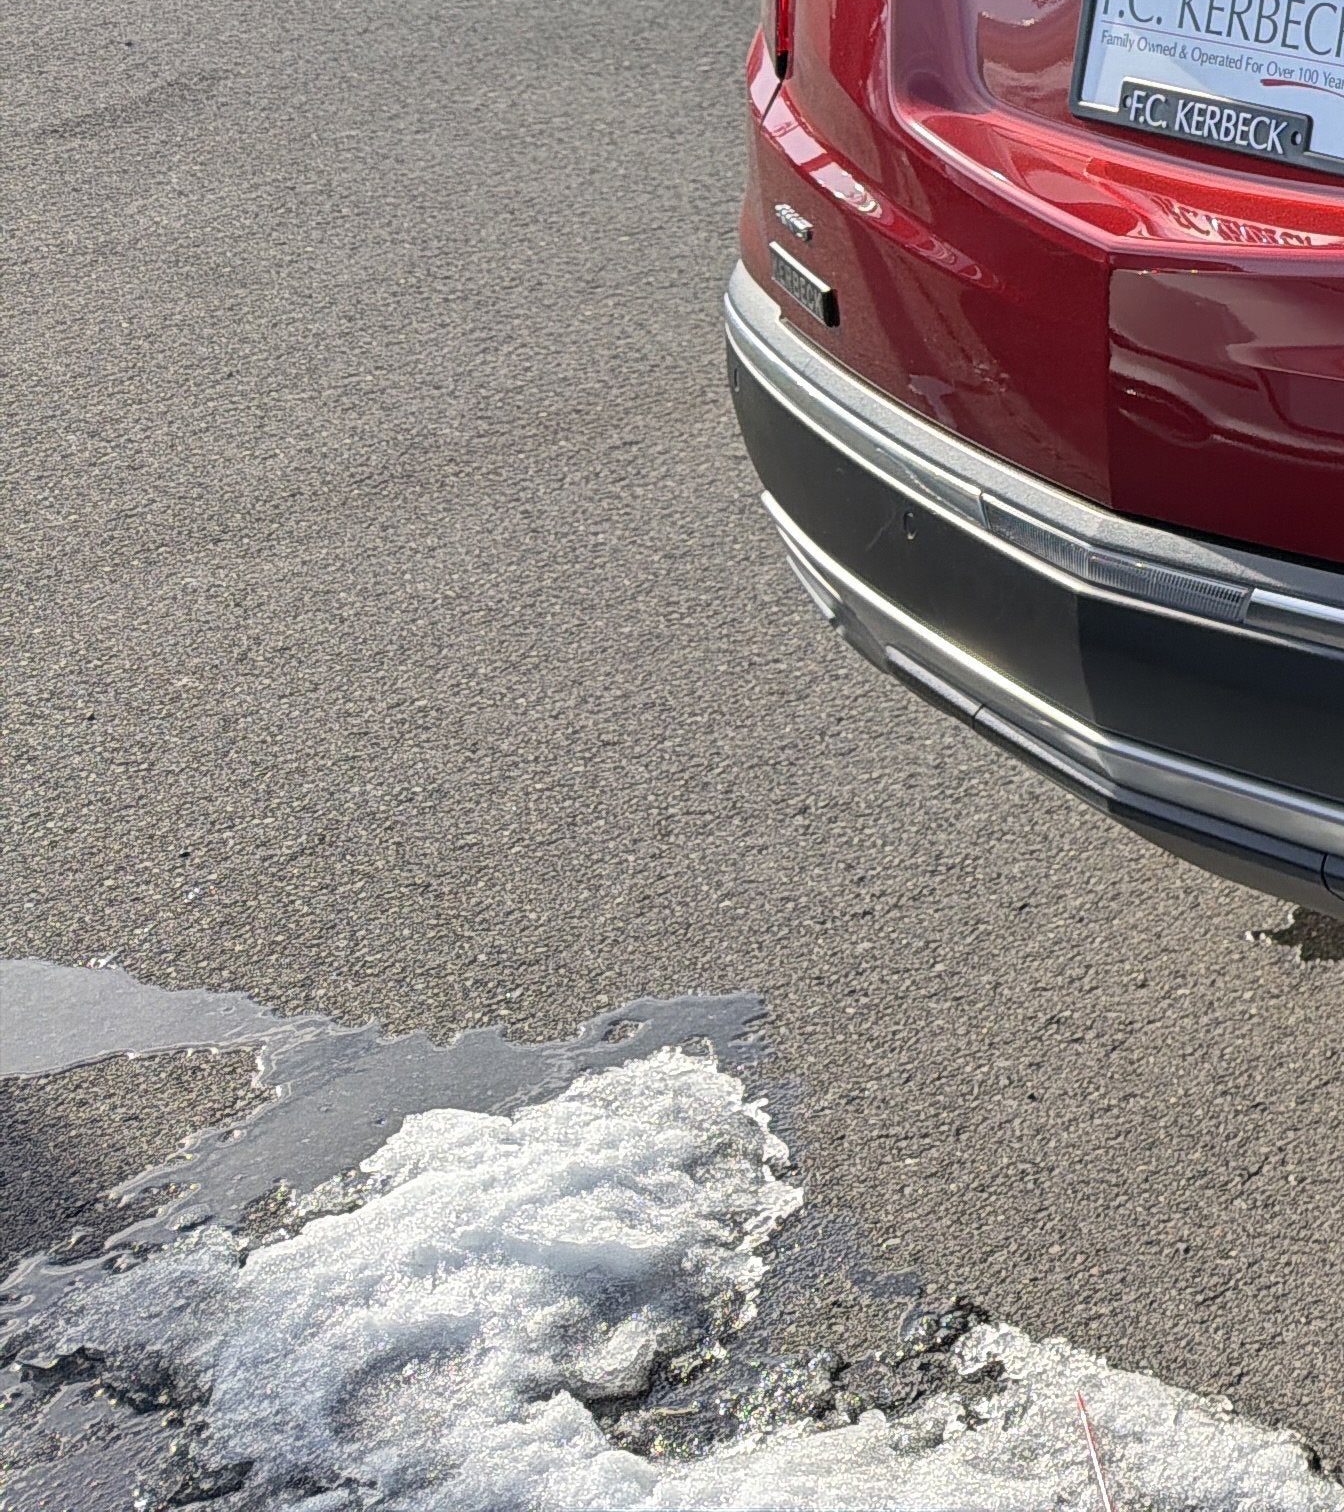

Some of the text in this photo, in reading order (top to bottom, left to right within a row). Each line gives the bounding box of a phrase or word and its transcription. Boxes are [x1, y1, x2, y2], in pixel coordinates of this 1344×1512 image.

[1101, 29, 1135, 53] Family
[1136, 36, 1177, 58] Owned
[1178, 44, 1188, 60] &
[1190, 46, 1244, 71] Operated
[1245, 57, 1265, 74] For
[1266, 60, 1296, 80] Over
[1298, 67, 1319, 85] 100
[1129, 89, 1289, 156] F.C. KERBECK
